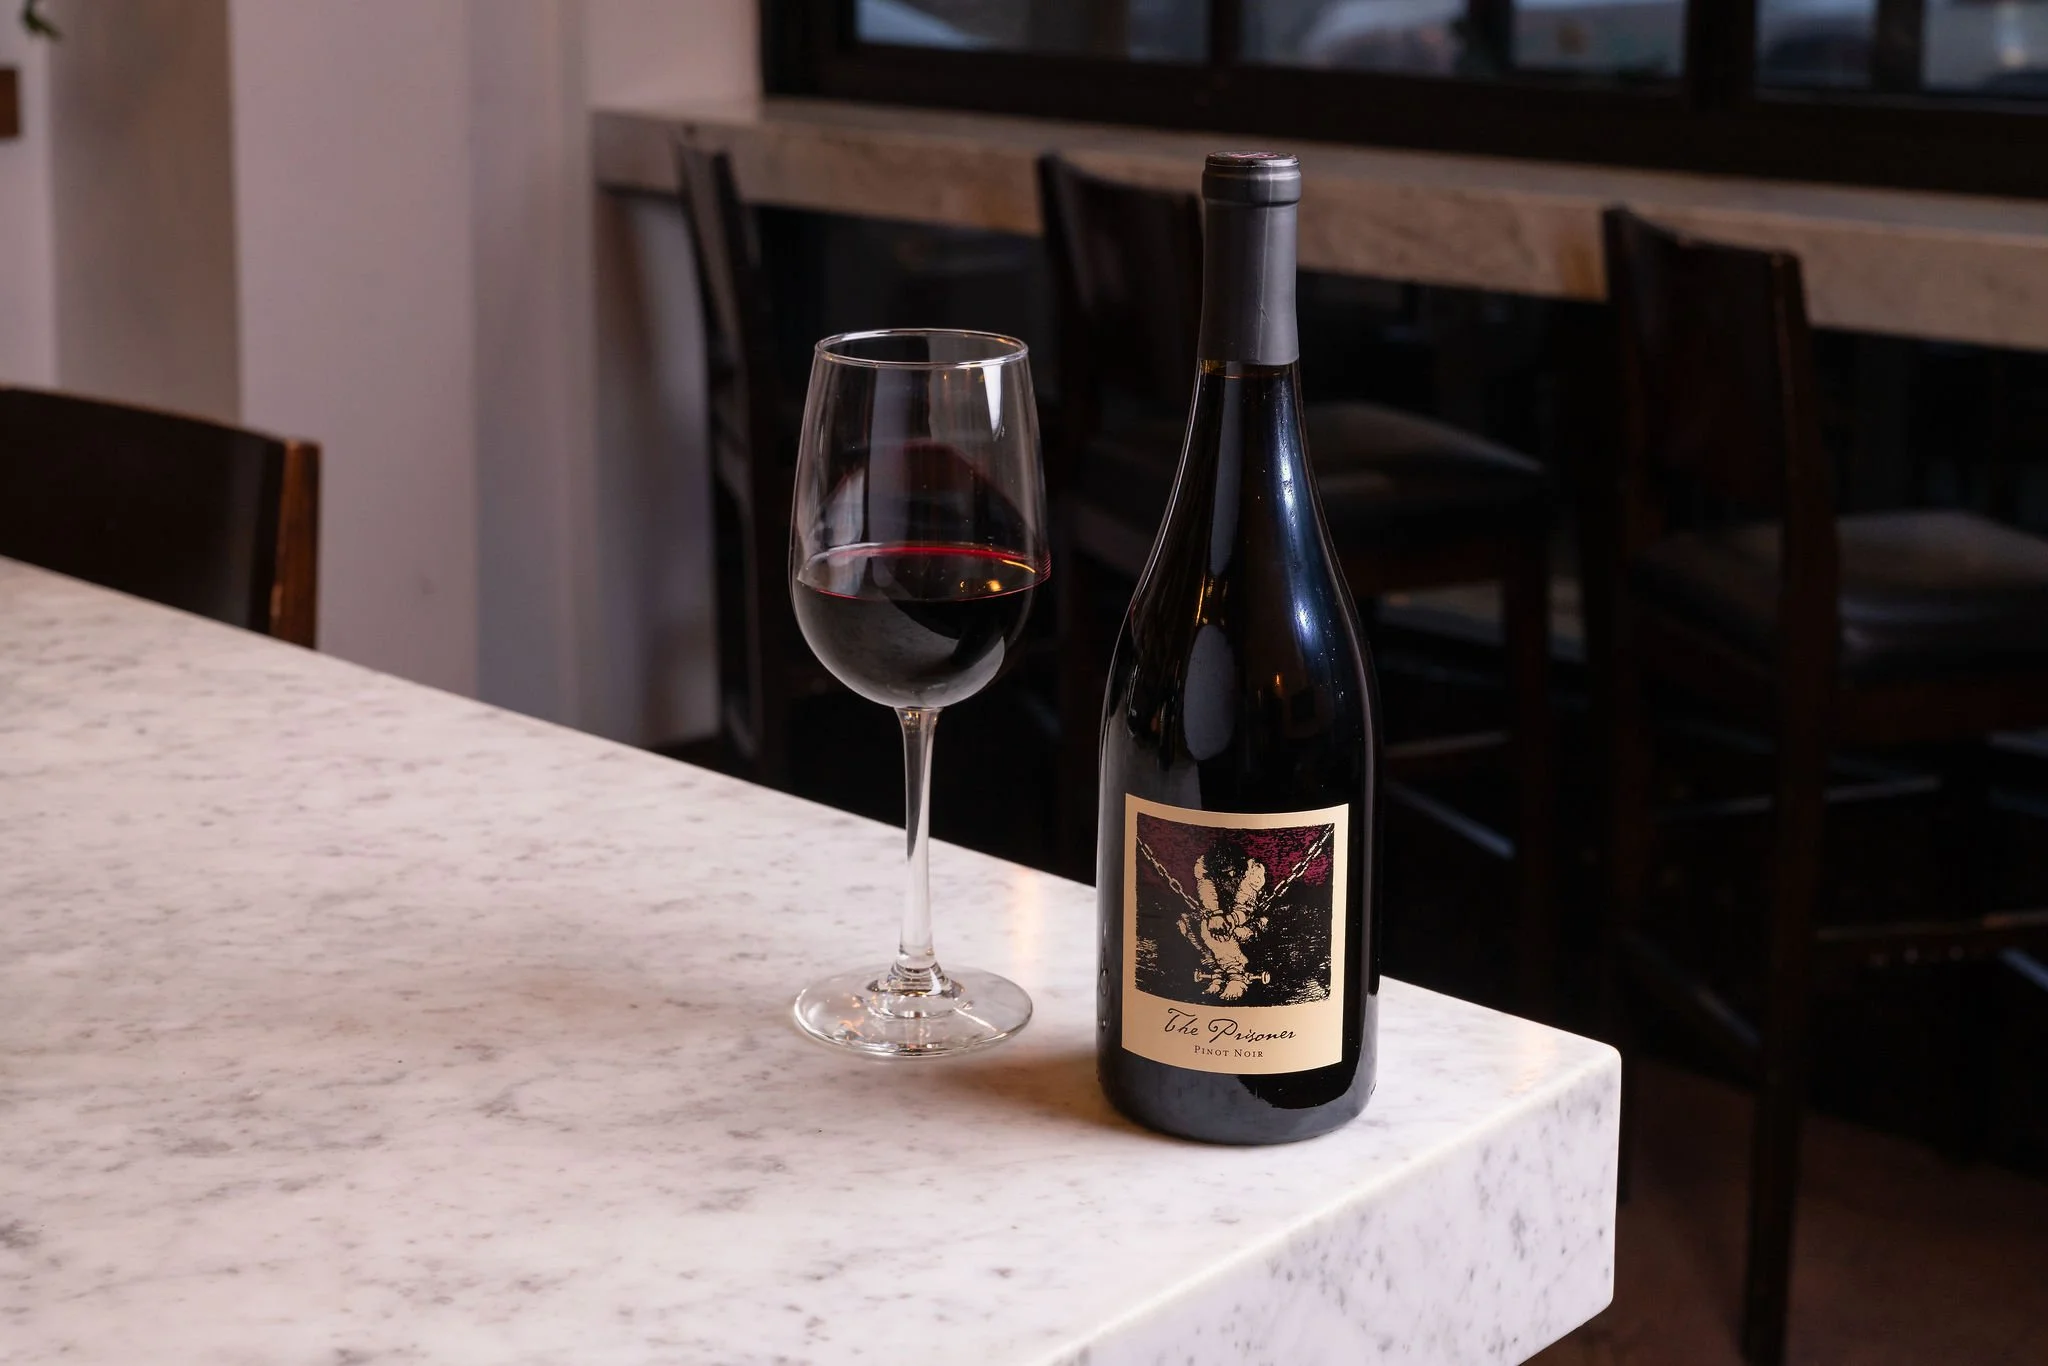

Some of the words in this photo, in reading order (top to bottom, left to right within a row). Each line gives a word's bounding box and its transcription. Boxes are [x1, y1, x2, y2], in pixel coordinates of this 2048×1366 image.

[1164, 1007, 1199, 1036] The
[1207, 1018, 1297, 1044] Prisoner
[1194, 1045, 1230, 1057] PINOT
[1234, 1048, 1264, 1058] NOIR
